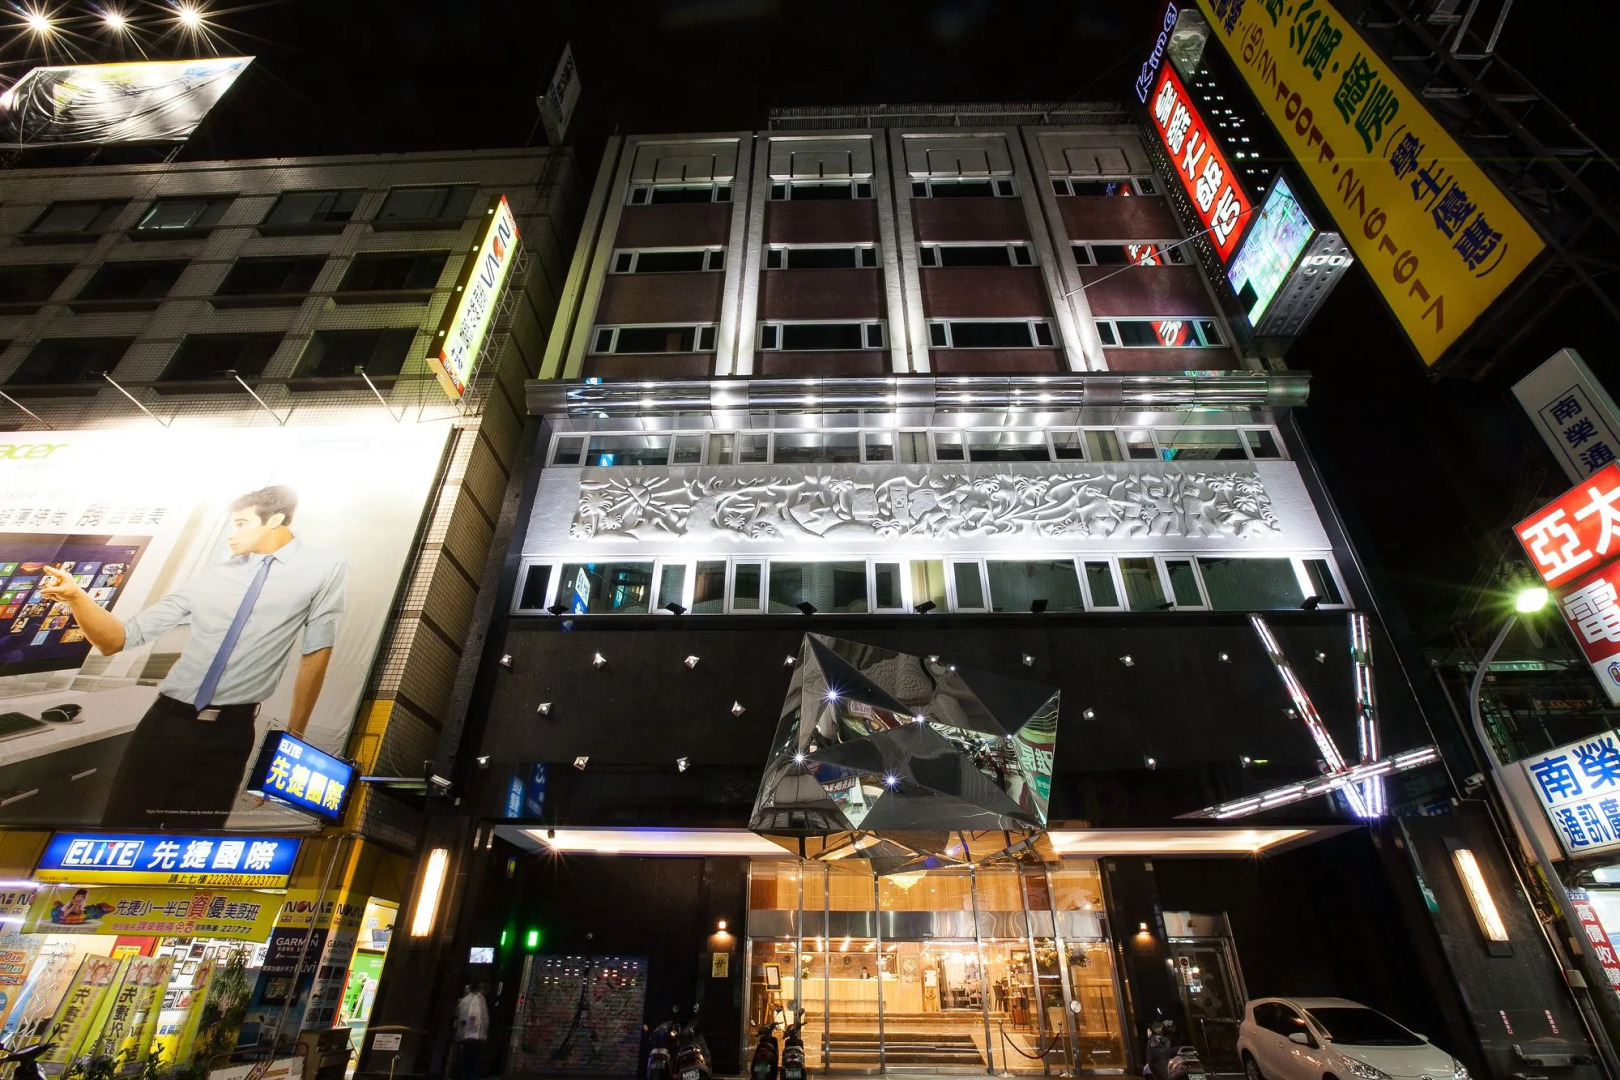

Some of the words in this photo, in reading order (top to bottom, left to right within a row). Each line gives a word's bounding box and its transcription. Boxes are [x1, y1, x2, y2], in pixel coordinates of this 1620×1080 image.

[1154, 79, 1242, 247] 皇爵大飯店
[0, 442, 70, 460] acer
[265, 755, 345, 811] 先捷國際
[1530, 737, 1620, 803] 南榮
[147, 841, 280, 871] 先捷國際
[276, 937, 320, 947] GARMN
